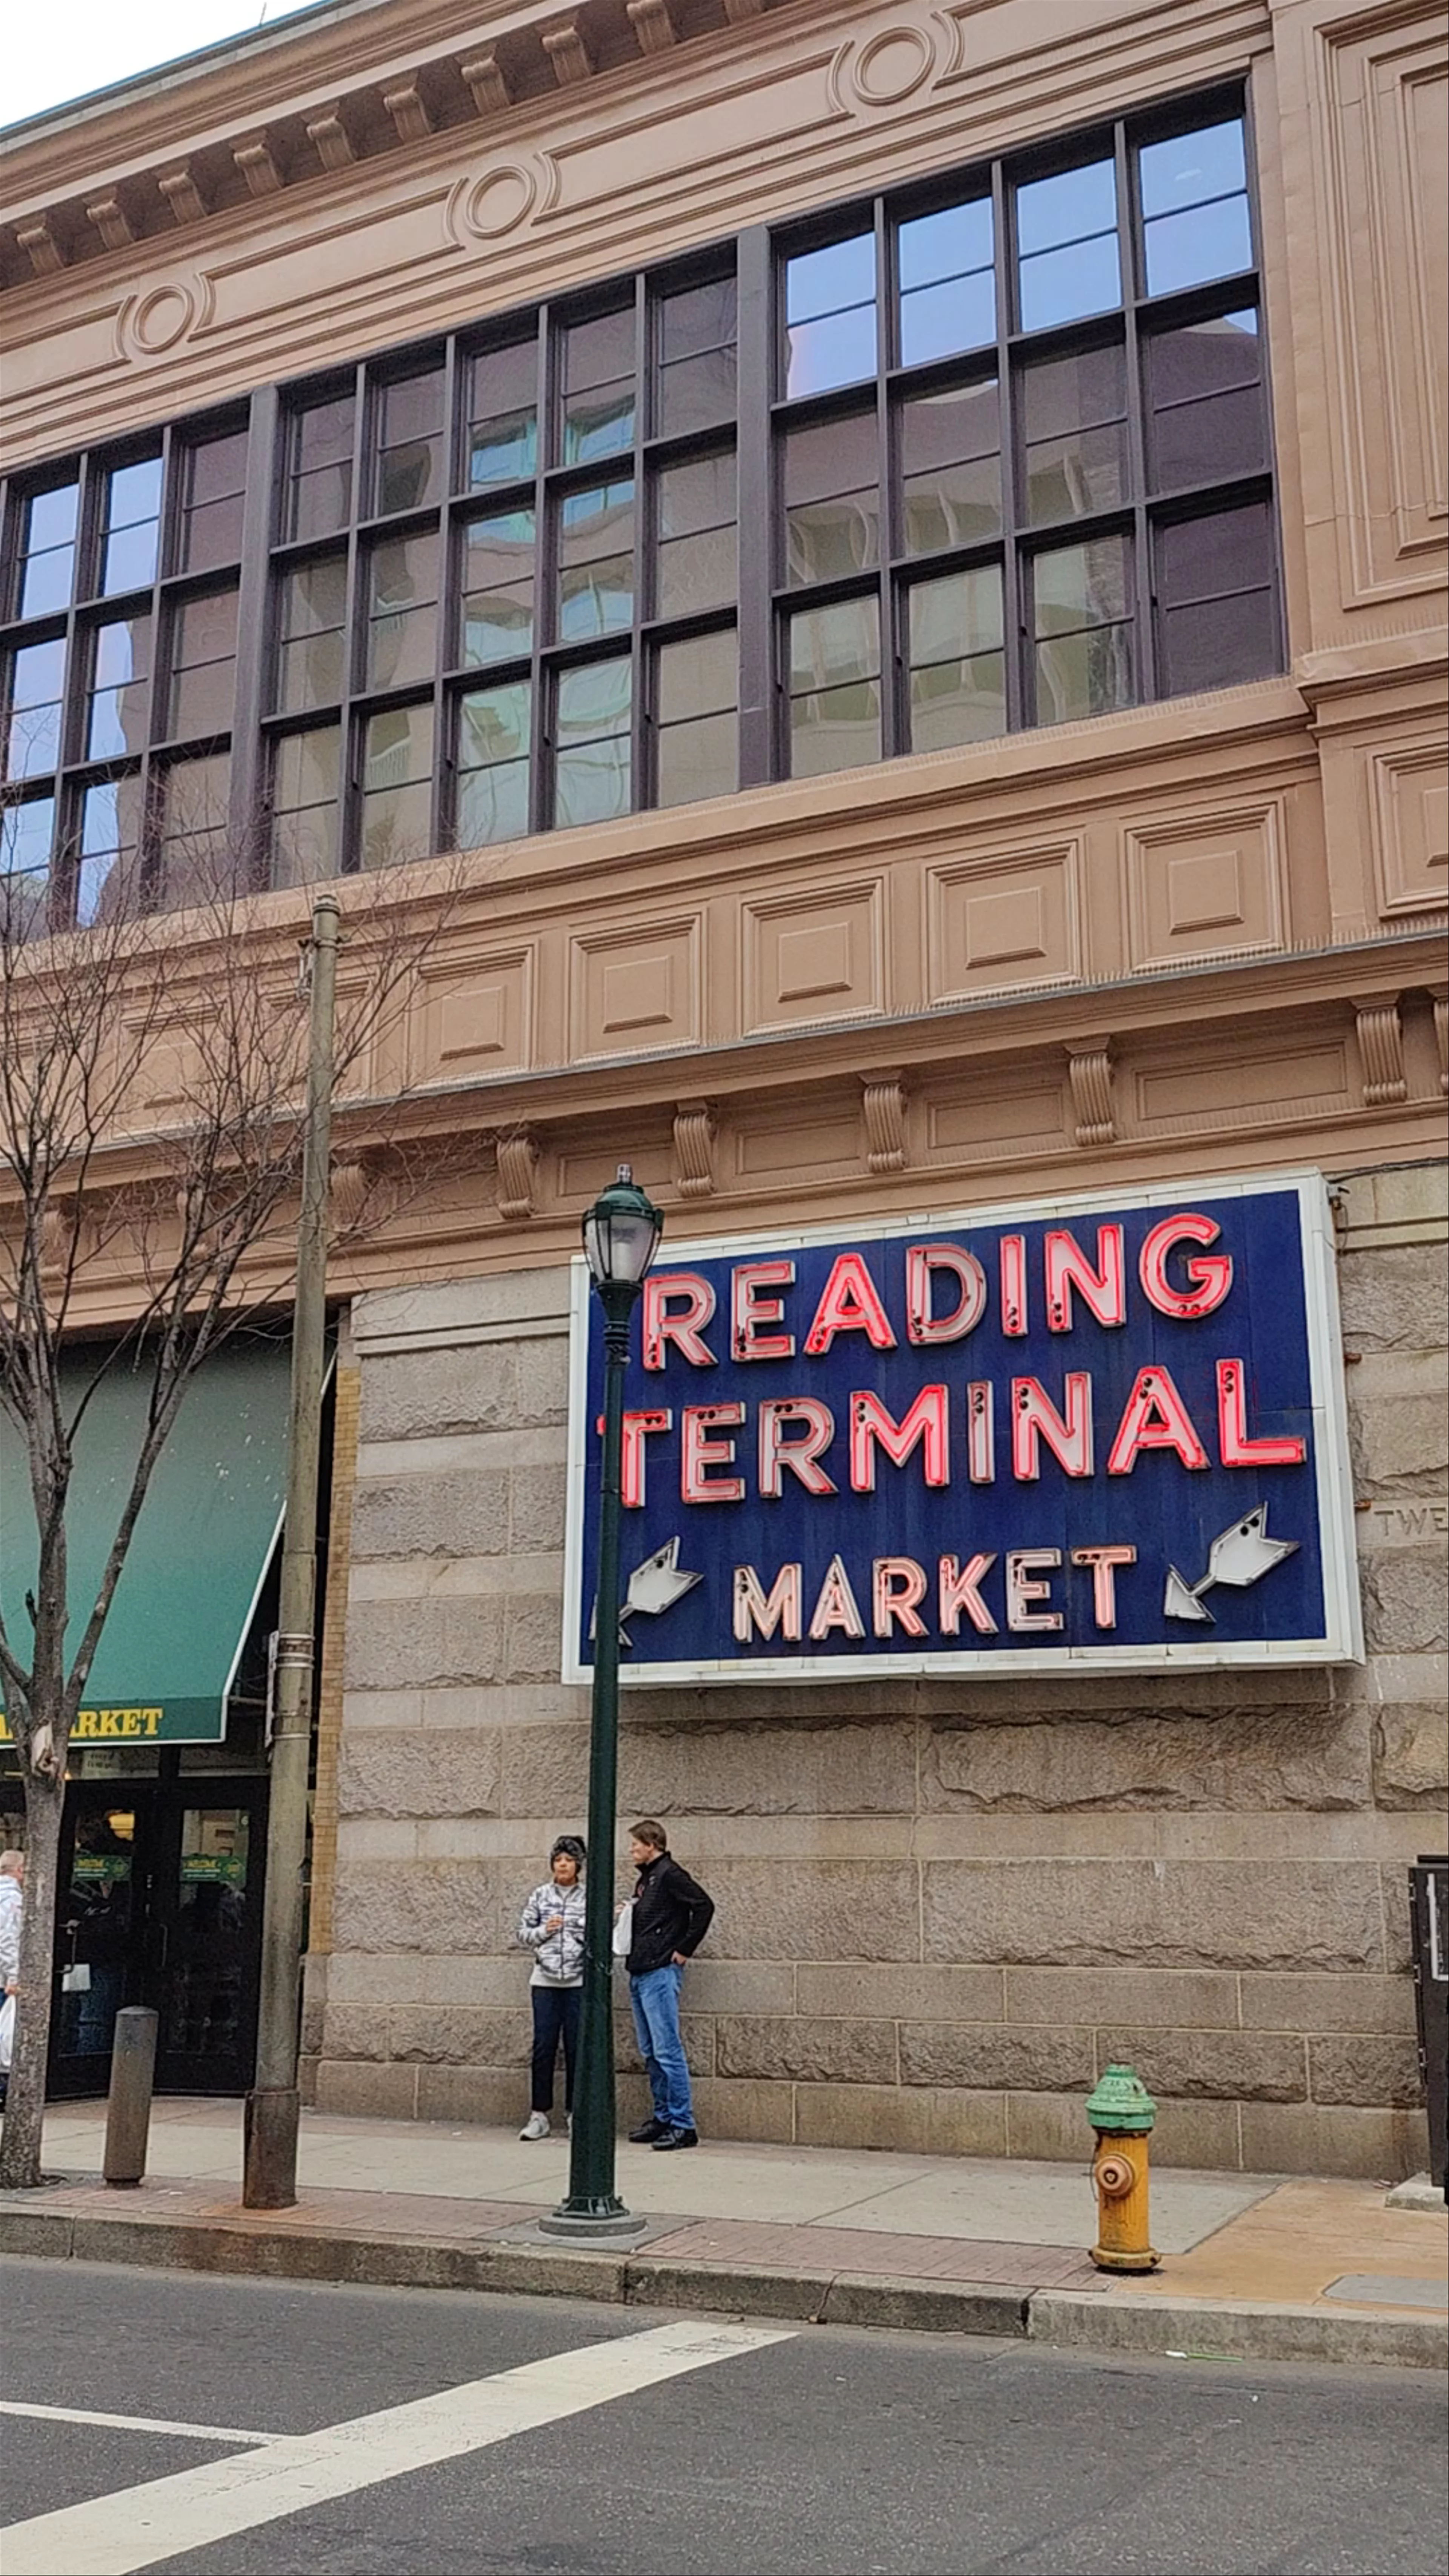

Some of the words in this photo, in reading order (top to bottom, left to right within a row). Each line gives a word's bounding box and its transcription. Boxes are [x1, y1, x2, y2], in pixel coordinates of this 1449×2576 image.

[642, 1213, 1233, 1370] READING
[597, 1358, 1306, 1507] TERMINAL
[733, 1546, 1137, 1643] MARKET
[69, 1708, 163, 1738] RKET
